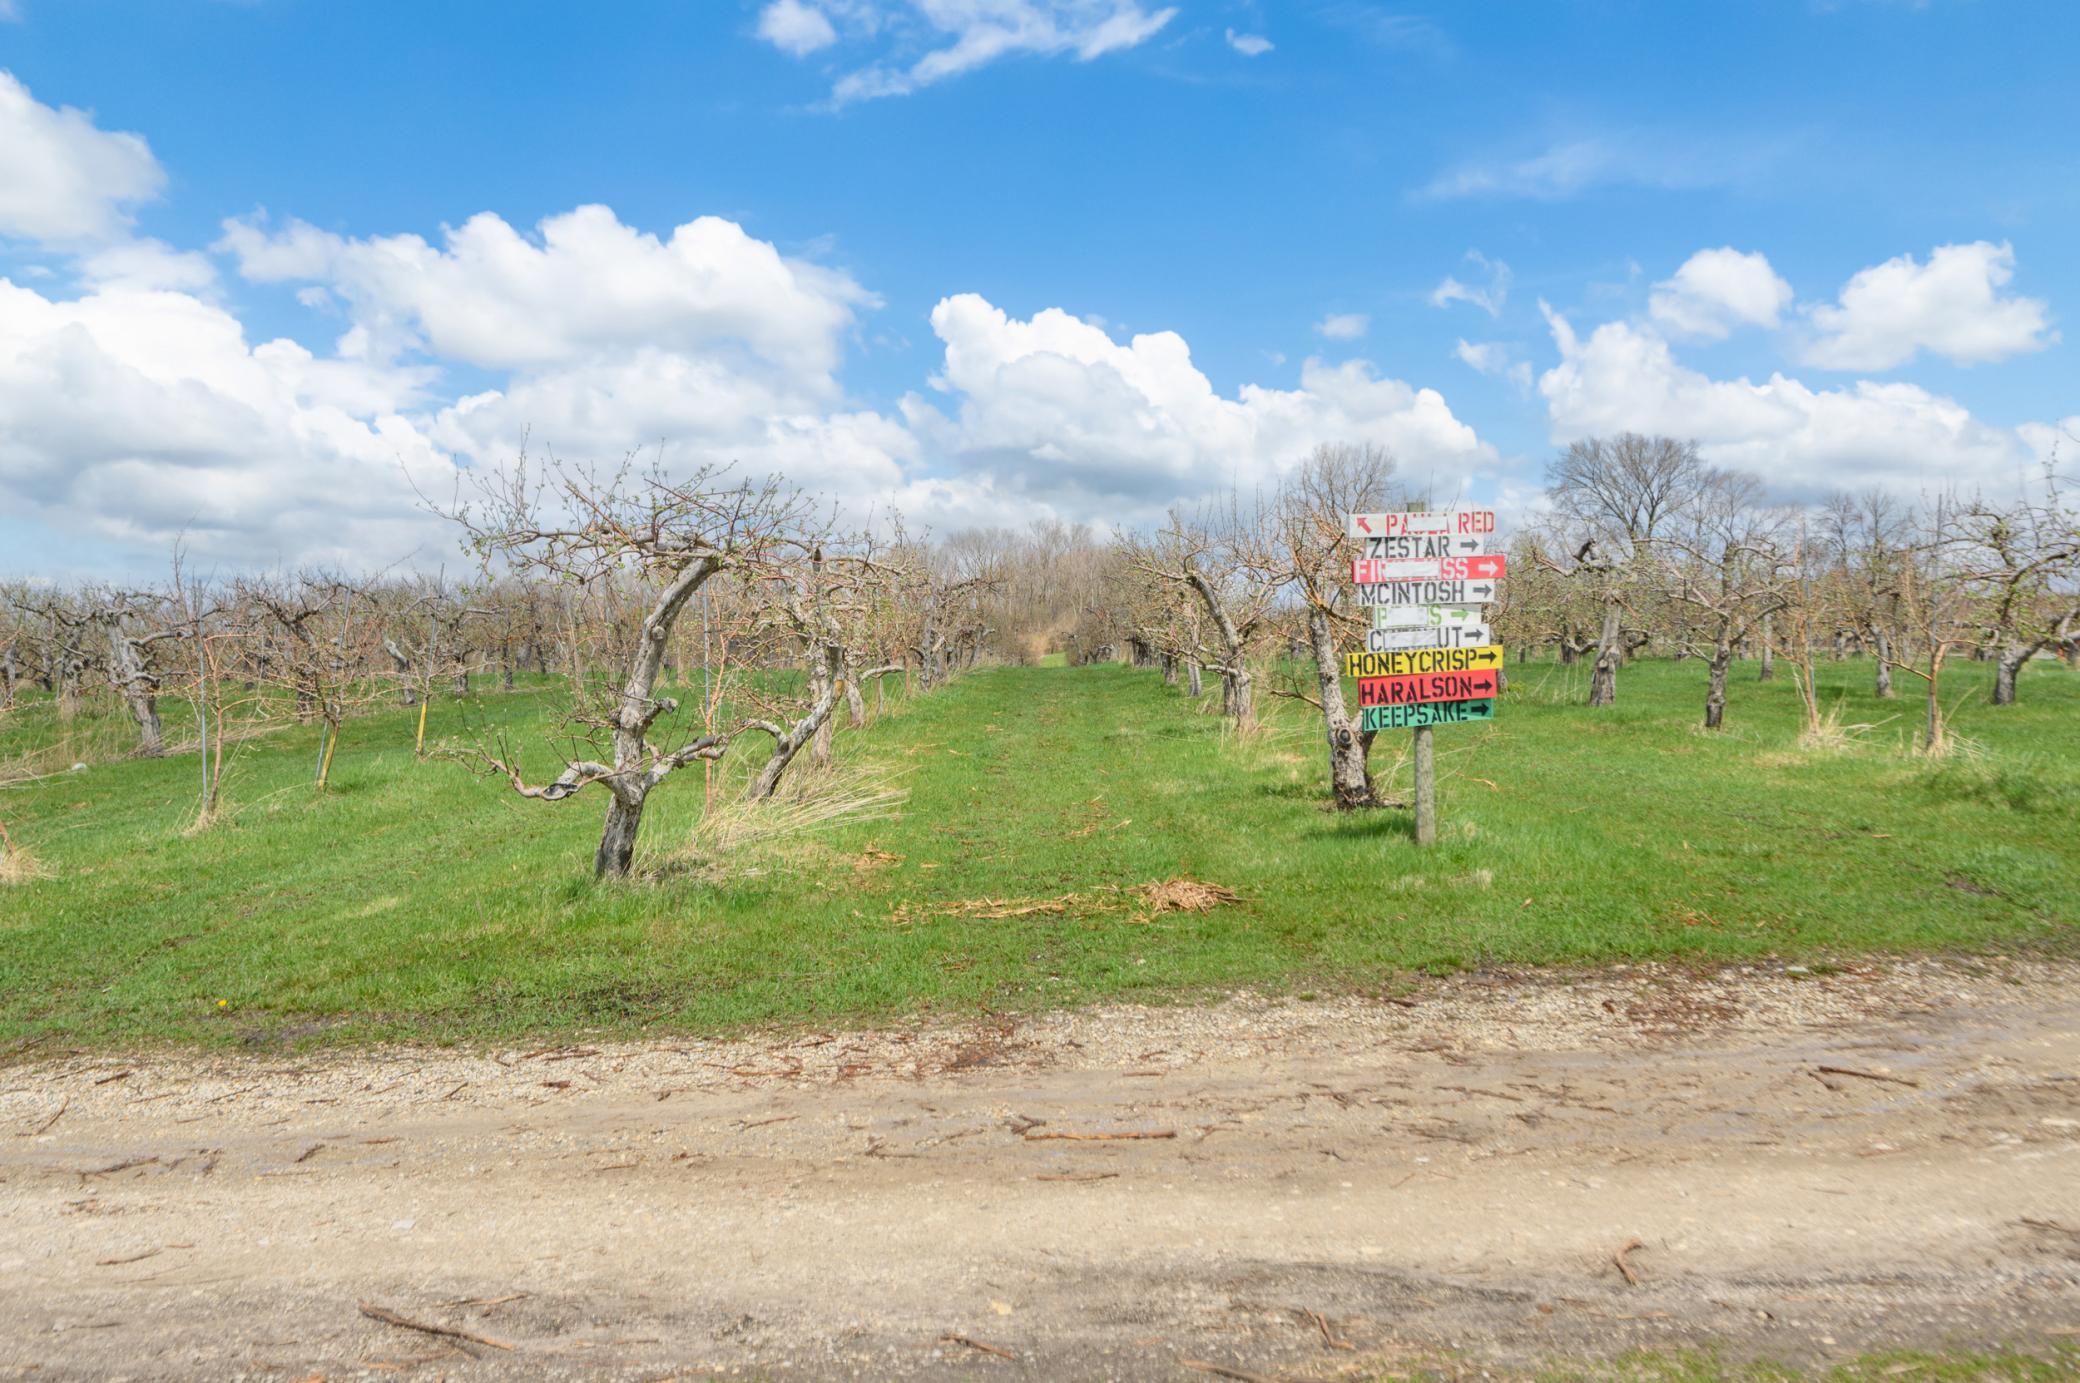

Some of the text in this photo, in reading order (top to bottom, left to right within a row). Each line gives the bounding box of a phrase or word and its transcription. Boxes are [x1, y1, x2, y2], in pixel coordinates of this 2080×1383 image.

[1458, 511, 1495, 534] RED
[1370, 535, 1449, 559] ZESTAR
[1361, 580, 1465, 605] MCINTOSH
[1350, 649, 1477, 676] HONEYCRISP
[1361, 676, 1472, 705] HARALSON
[1364, 700, 1469, 730] KEEPSAKE
